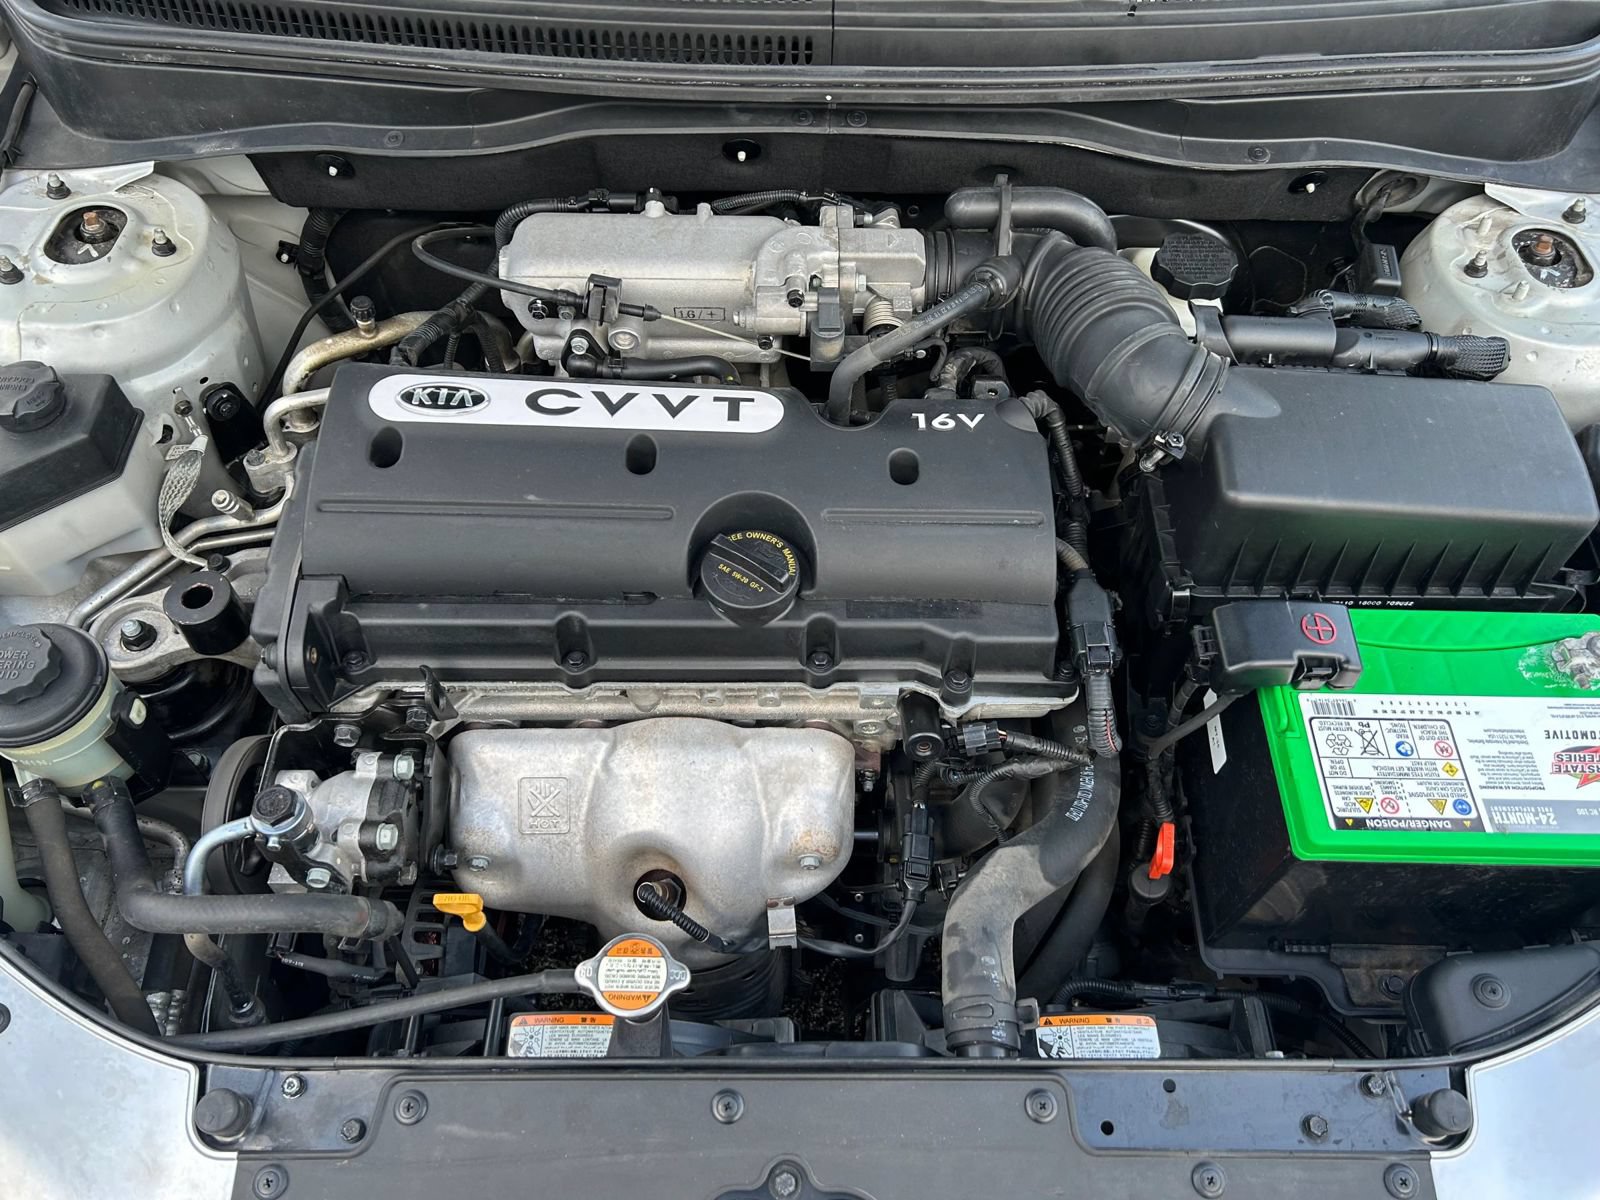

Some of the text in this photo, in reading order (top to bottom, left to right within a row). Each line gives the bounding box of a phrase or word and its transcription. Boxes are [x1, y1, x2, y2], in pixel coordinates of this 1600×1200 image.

[411, 387, 473, 407] KIA
[525, 388, 755, 422] CVVT
[911, 412, 986, 431] 16V
[746, 531, 784, 549] OWNER'S
[718, 563, 731, 574] SAE
[0, 650, 28, 659] OWER
[0, 660, 35, 669] ERING
[1358, 721, 1371, 729] Pb
[1544, 730, 1600, 740] OMOTIVE
[1554, 764, 1600, 774] RSTATE
[1365, 818, 1452, 829] DANGER/POISON
[1491, 811, 1558, 825] 24-MONTH
